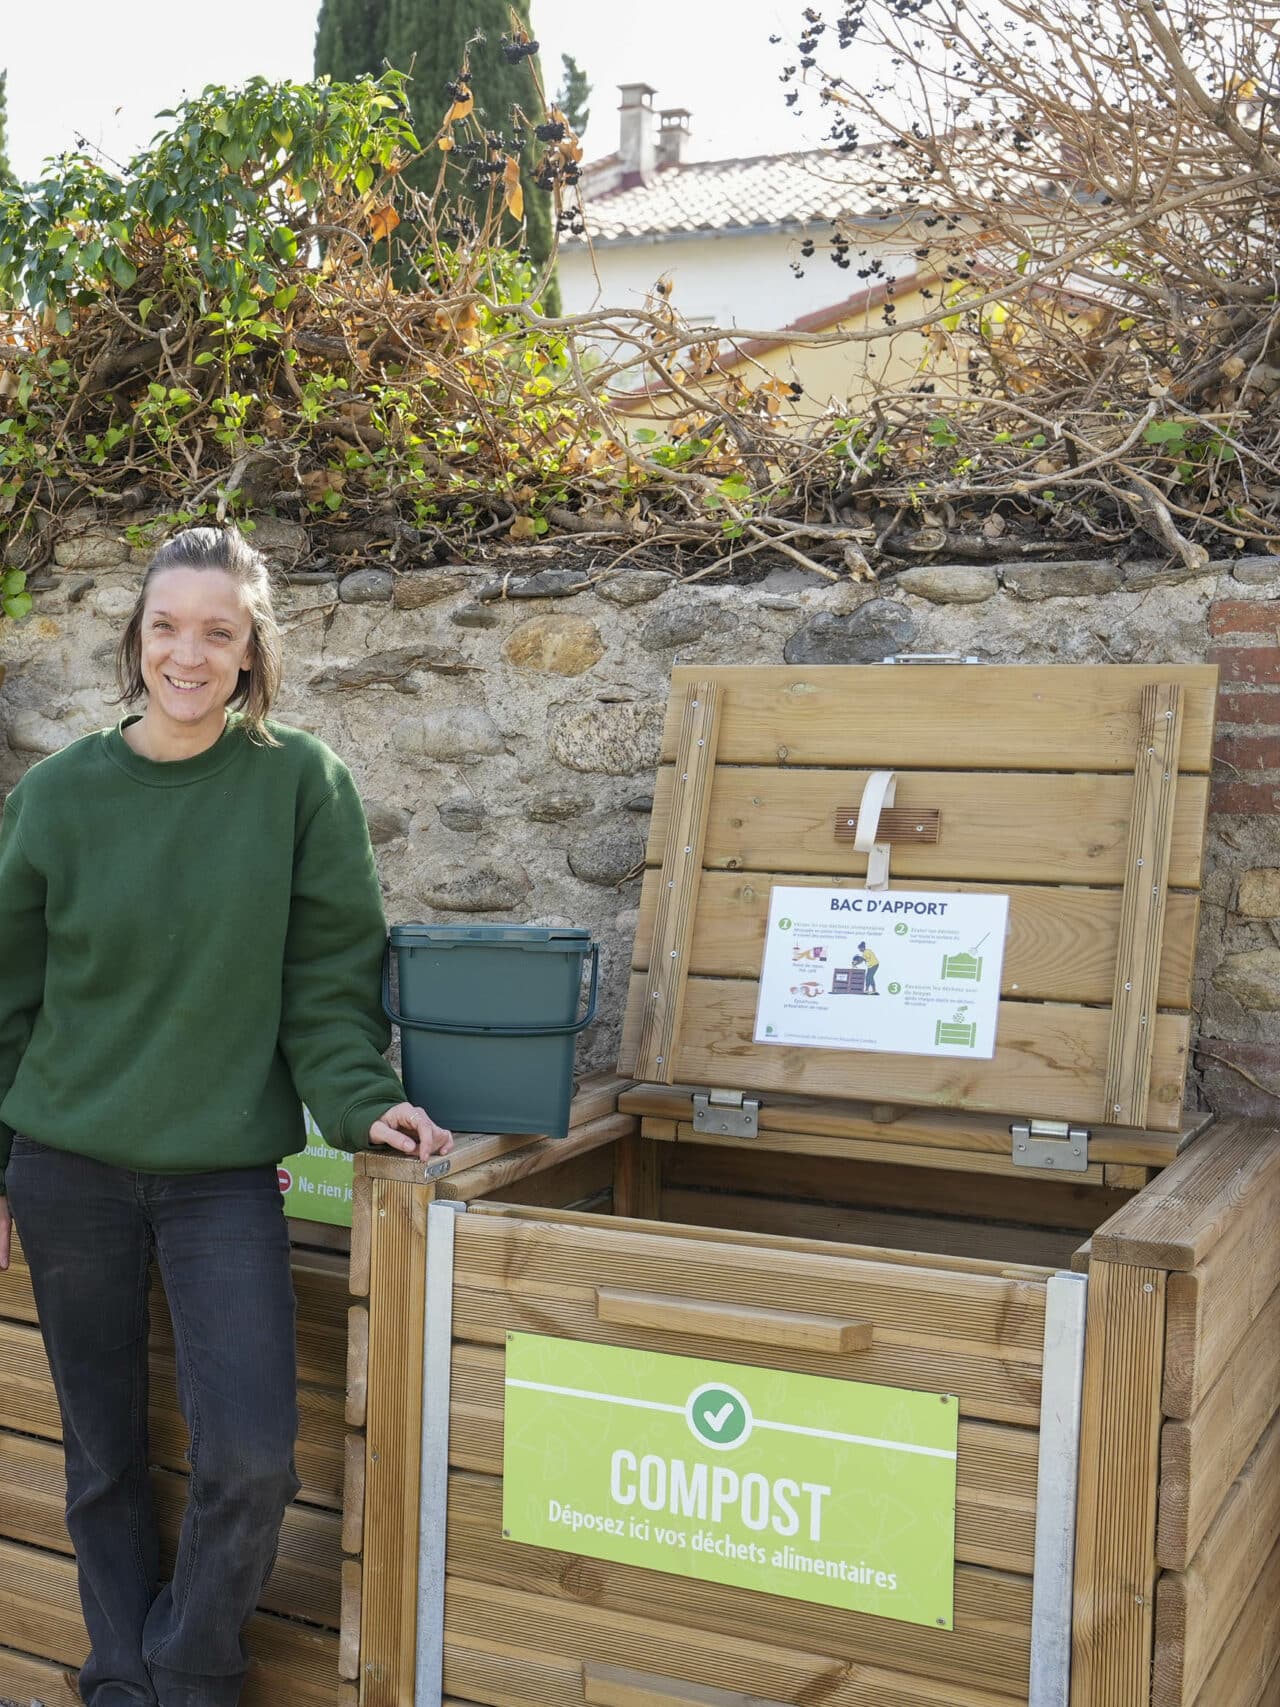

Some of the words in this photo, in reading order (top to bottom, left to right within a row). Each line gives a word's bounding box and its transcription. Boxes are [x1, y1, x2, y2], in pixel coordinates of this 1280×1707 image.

[830, 898, 863, 912] BAC
[867, 899, 948, 916] D'APPORT
[297, 1144, 338, 1160] oudrer
[299, 1176, 314, 1193] Ne
[318, 1181, 341, 1198] rien
[610, 1449, 831, 1542] COMPOST
[548, 1500, 625, 1537] Déposez
[630, 1516, 650, 1541] ici
[654, 1526, 686, 1549] vos
[691, 1528, 766, 1565] déchets
[771, 1550, 898, 1590] alimentaires
